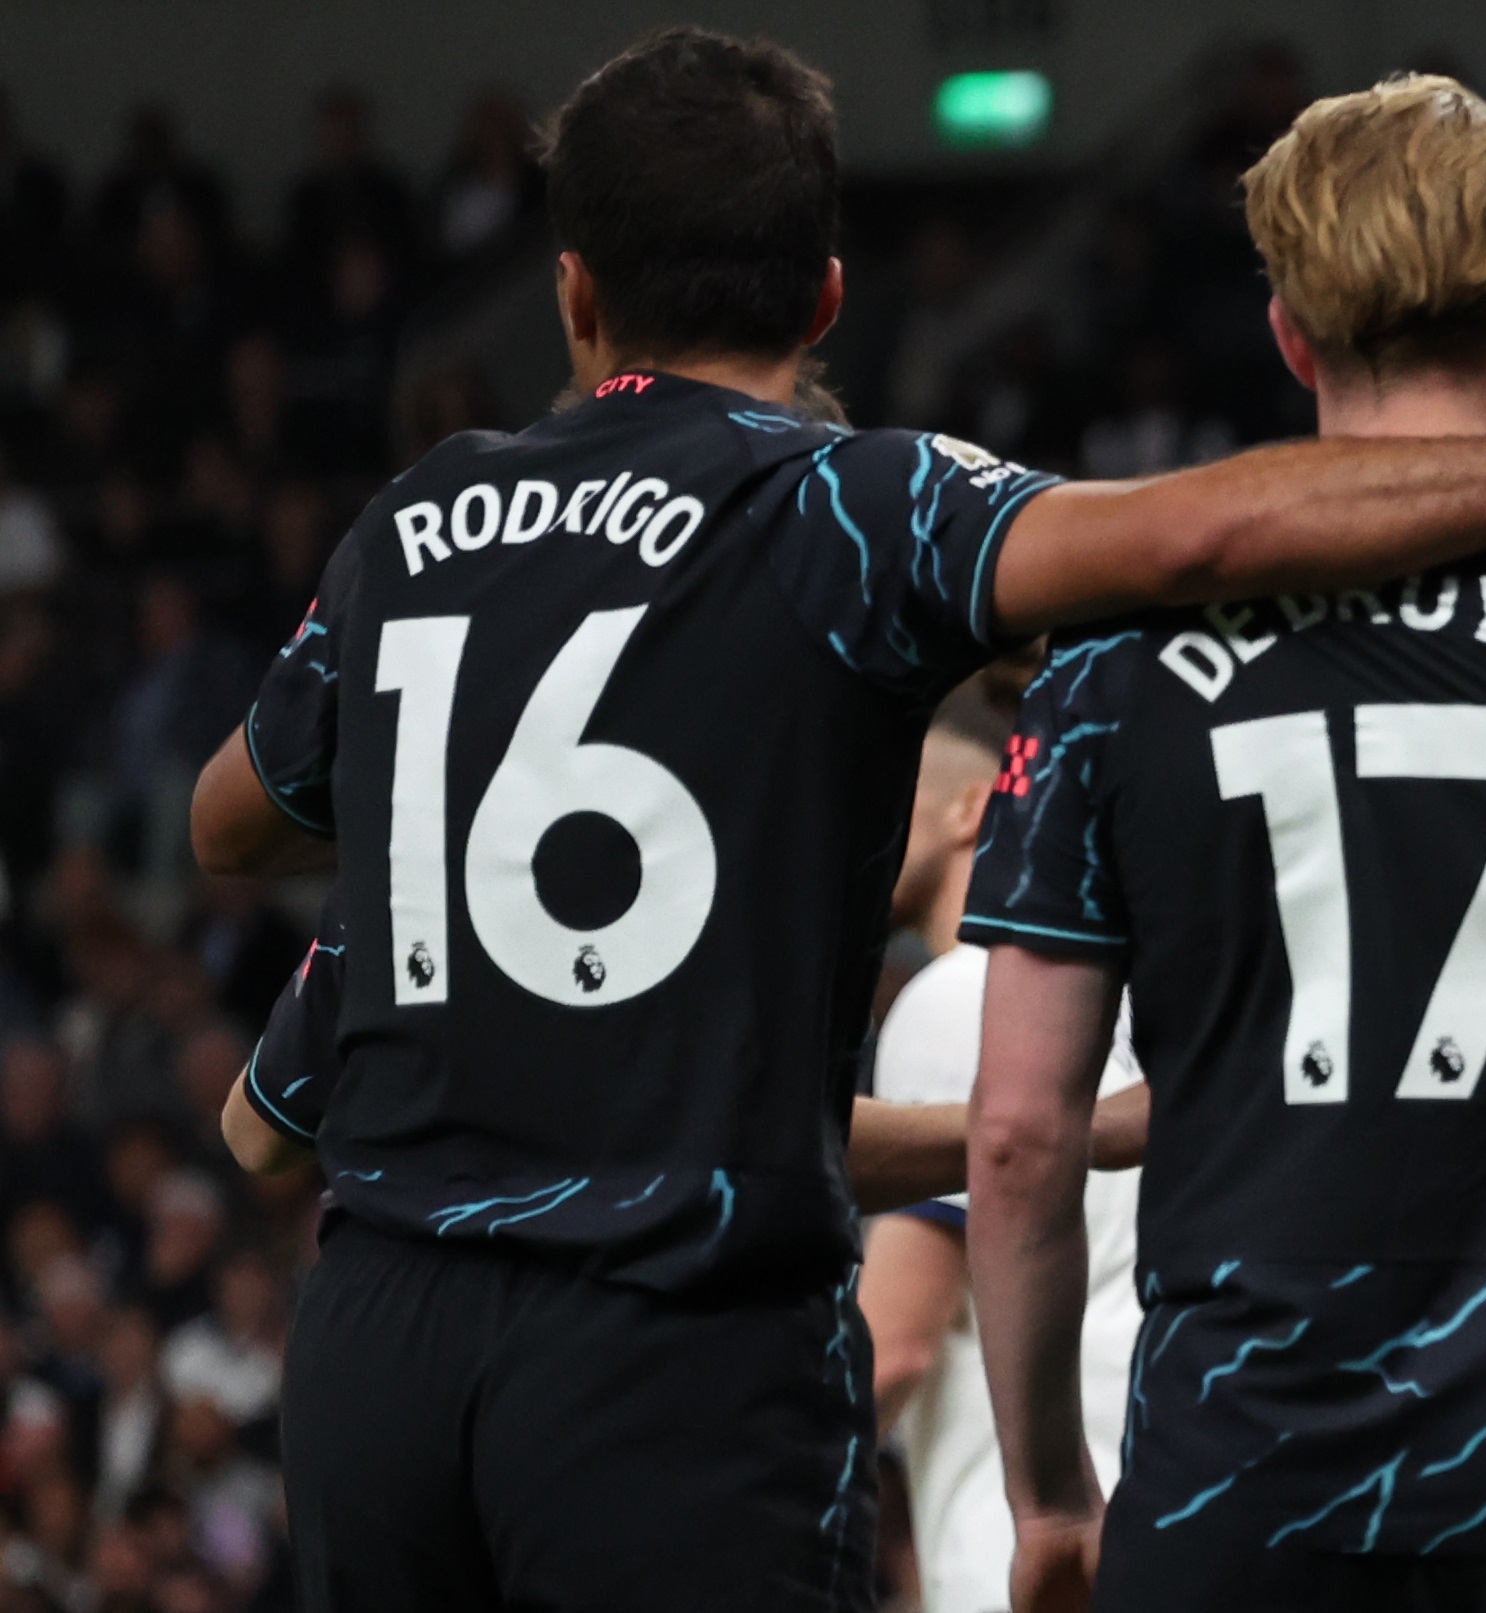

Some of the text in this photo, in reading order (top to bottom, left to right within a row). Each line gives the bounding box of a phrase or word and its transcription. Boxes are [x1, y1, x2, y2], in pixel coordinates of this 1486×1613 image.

[595, 374, 655, 399] CITY
[393, 471, 705, 577] RODRIGO
[1158, 601, 1279, 702] DE
[374, 602, 718, 1008] 16
